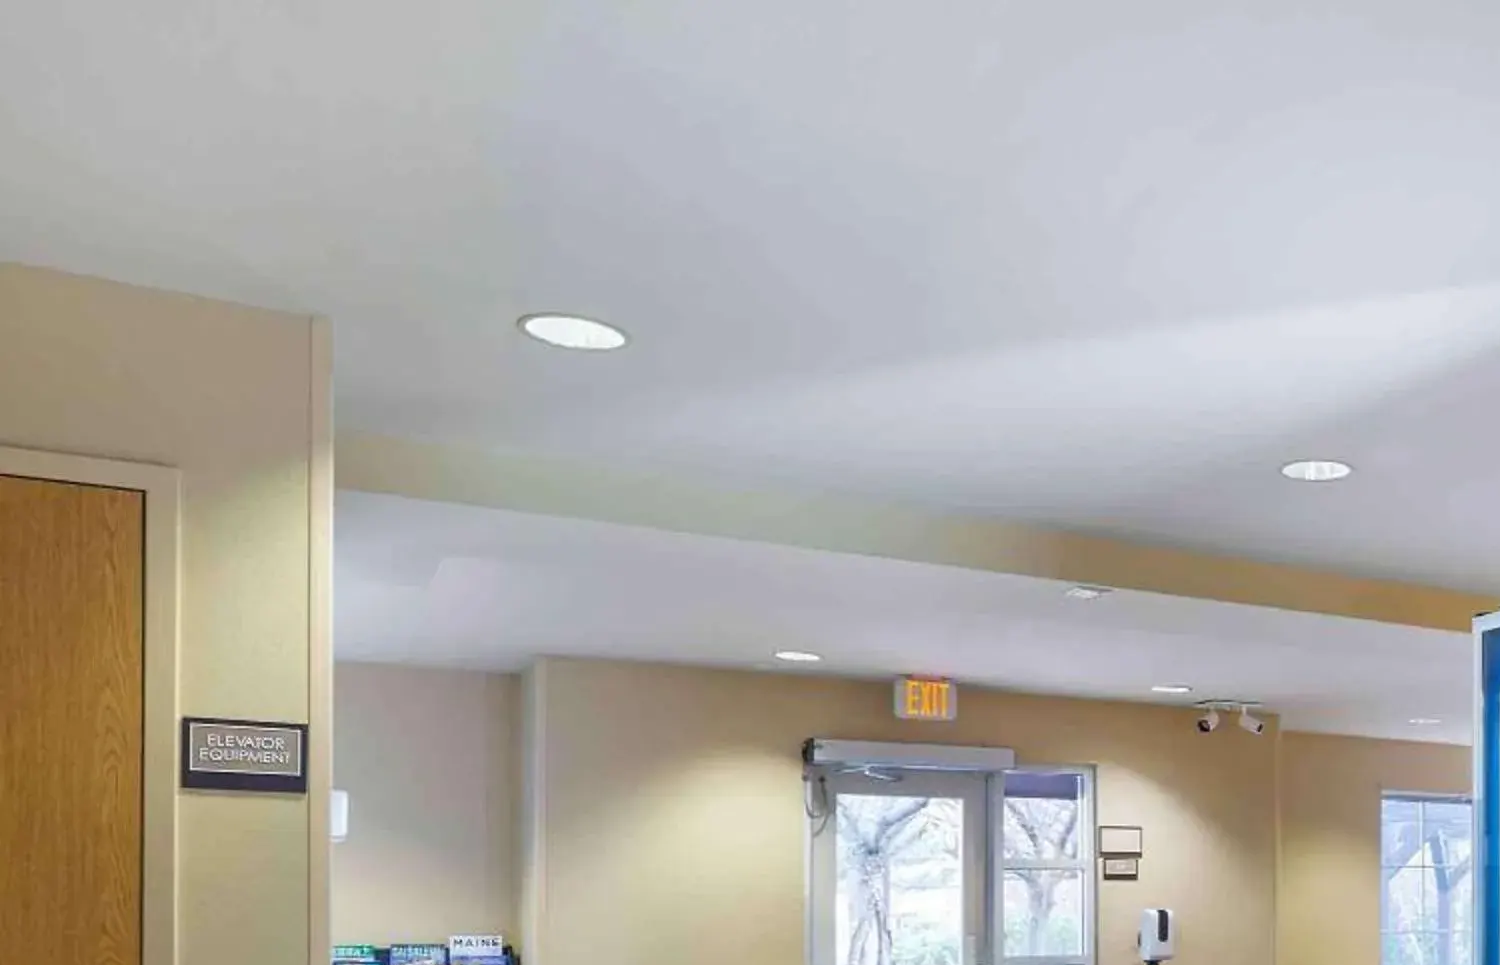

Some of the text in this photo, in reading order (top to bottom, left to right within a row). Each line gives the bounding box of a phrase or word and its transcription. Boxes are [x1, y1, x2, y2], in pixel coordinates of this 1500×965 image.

[906, 681, 949, 717] EXIT
[207, 733, 285, 750] ELEVATOR
[199, 748, 290, 764] EQUIPMENT
